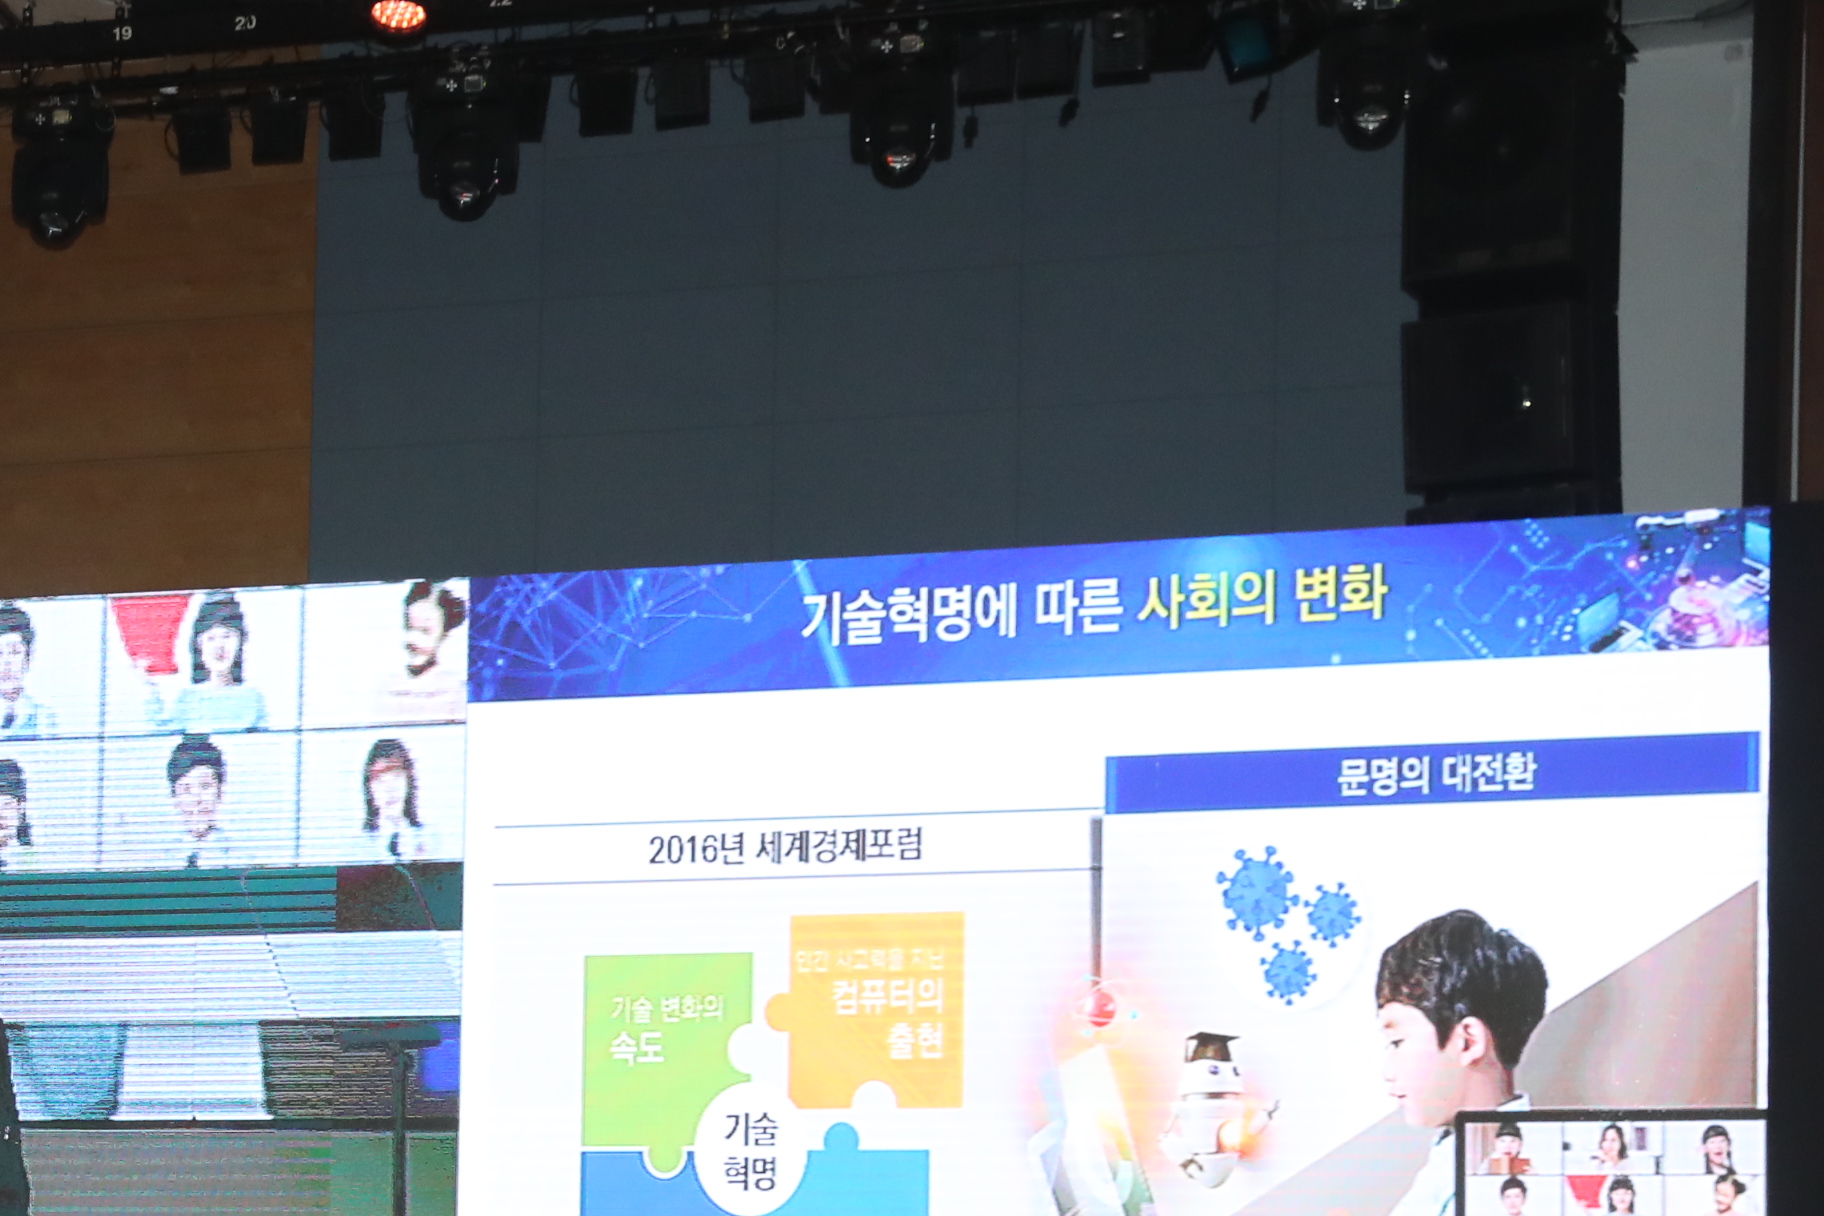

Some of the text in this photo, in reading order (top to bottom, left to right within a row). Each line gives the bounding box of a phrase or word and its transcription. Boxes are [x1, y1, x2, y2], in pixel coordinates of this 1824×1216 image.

[112, 26, 133, 42] 19
[234, 15, 257, 31] 20
[800, 562, 1389, 648] 기술혁명에 따른 사회의 변화
[1336, 751, 1537, 798] 문명의 대전환
[648, 826, 924, 866] 2016년 세계경제포럼
[611, 994, 724, 1023] 기술 변화의
[832, 978, 945, 1016] 컴퓨터의
[610, 1031, 665, 1066] 속도
[887, 1022, 944, 1060] 출현
[724, 1111, 780, 1148] 기술
[723, 1155, 777, 1192] 혁명
